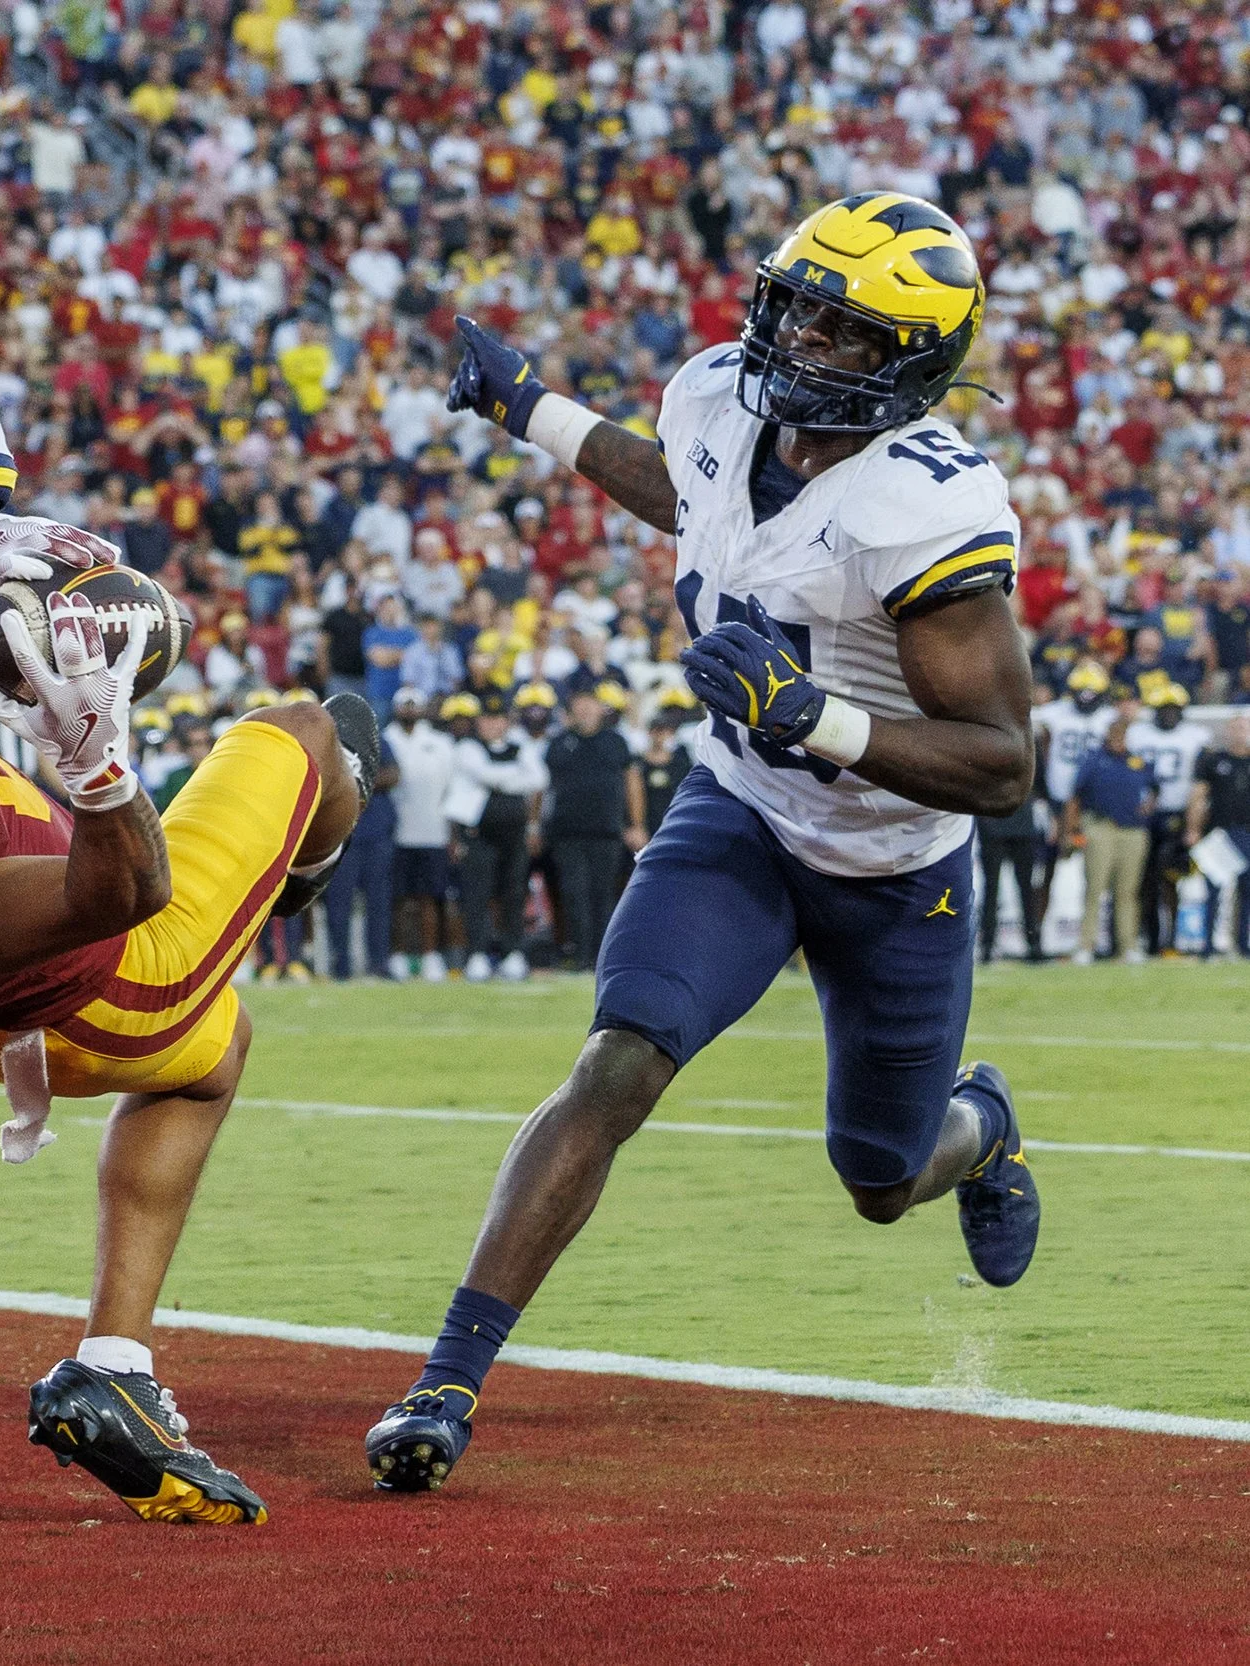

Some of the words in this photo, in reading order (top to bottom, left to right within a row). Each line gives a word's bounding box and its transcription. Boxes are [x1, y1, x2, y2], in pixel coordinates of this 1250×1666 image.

[803, 265, 826, 285] M
[887, 429, 990, 485] 15
[675, 498, 689, 538] C
